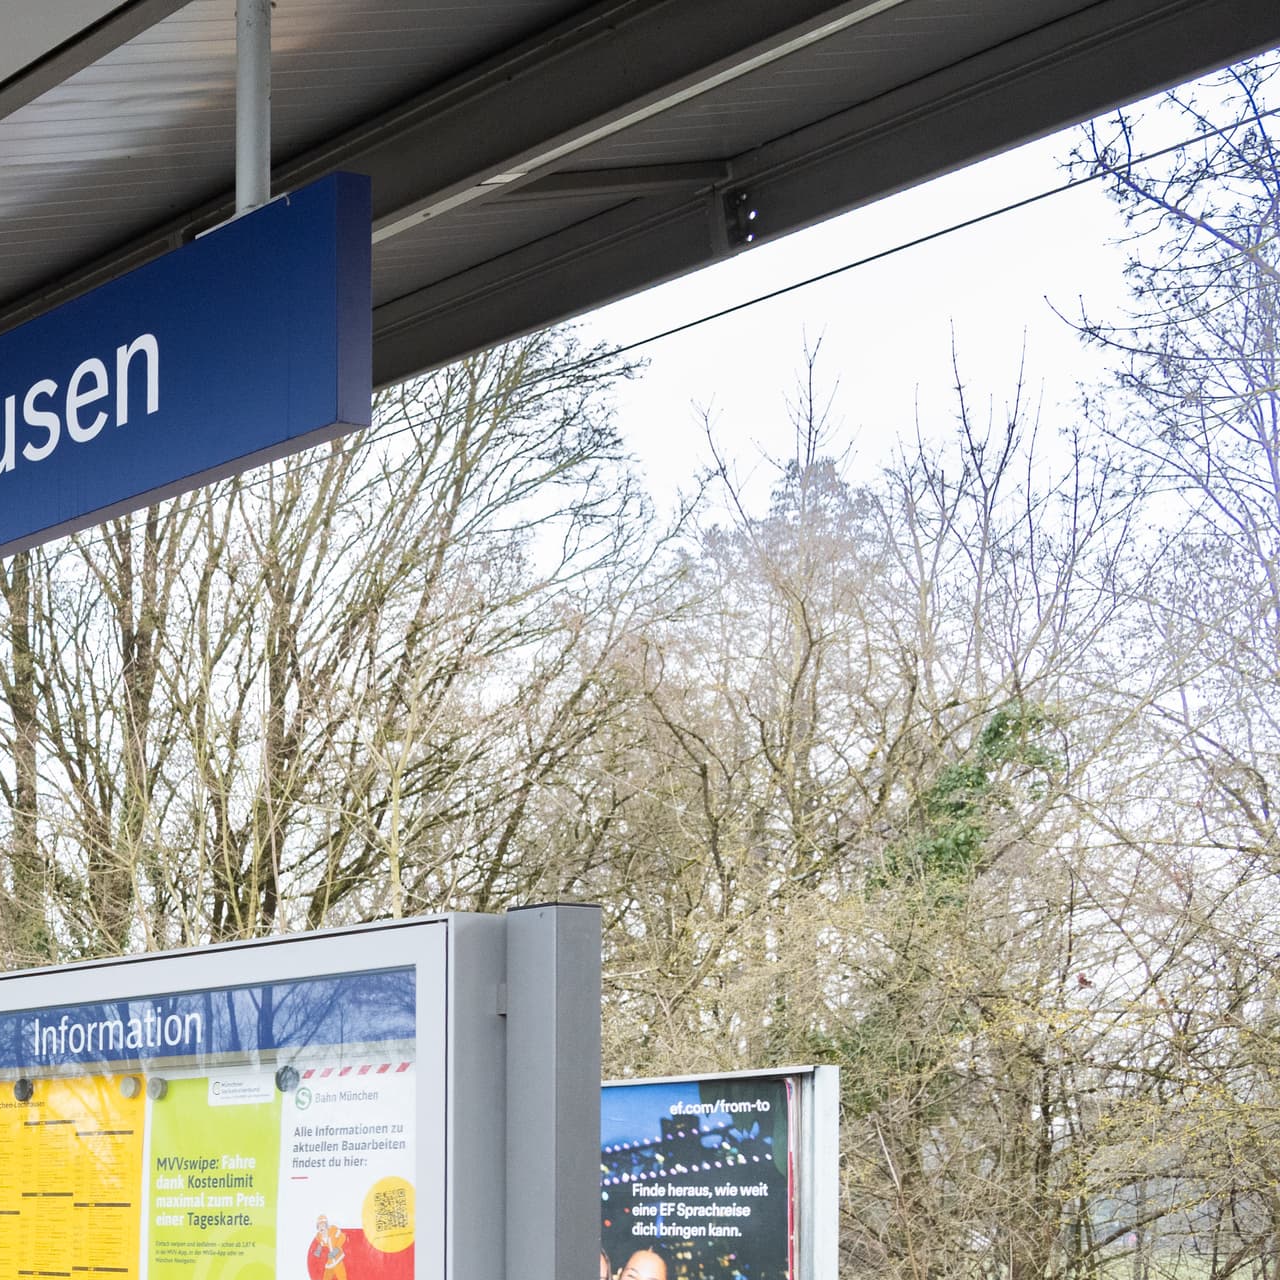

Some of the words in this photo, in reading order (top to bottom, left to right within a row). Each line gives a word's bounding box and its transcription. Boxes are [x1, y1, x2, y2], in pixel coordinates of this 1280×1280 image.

[33, 1007, 203, 1057] Information
[315, 1091, 336, 1103] Bahn
[339, 1090, 378, 1102] München
[670, 1099, 770, 1115] ef.com/from-to
[294, 1126, 312, 1137] Alle
[316, 1124, 388, 1136] Informationen
[391, 1124, 403, 1133] zu
[293, 1140, 338, 1153] aktuellen
[342, 1140, 406, 1152] Bauarbeiten
[156, 1158, 220, 1173] MVVswipe:
[222, 1156, 256, 1169] Fahre
[292, 1157, 326, 1168] findest
[329, 1157, 342, 1168] du
[344, 1156, 368, 1167] hier:
[156, 1175, 184, 1189] dank
[188, 1174, 253, 1188] Kostenlimit
[633, 1183, 665, 1197] Finde
[668, 1183, 713, 1199] heraus,
[715, 1183, 738, 1197] wie
[740, 1182, 769, 1197] weit
[156, 1194, 205, 1208] maximal
[208, 1195, 232, 1208] zum
[236, 1193, 264, 1208] Preis
[632, 1204, 657, 1217] eine
[660, 1203, 675, 1216] EF
[677, 1203, 751, 1219] Sprachreise
[156, 1213, 184, 1226] einer
[188, 1212, 252, 1230] Tageskarte.
[632, 1222, 657, 1236] dich
[660, 1222, 706, 1239] bringen
[708, 1222, 742, 1237] kann.
